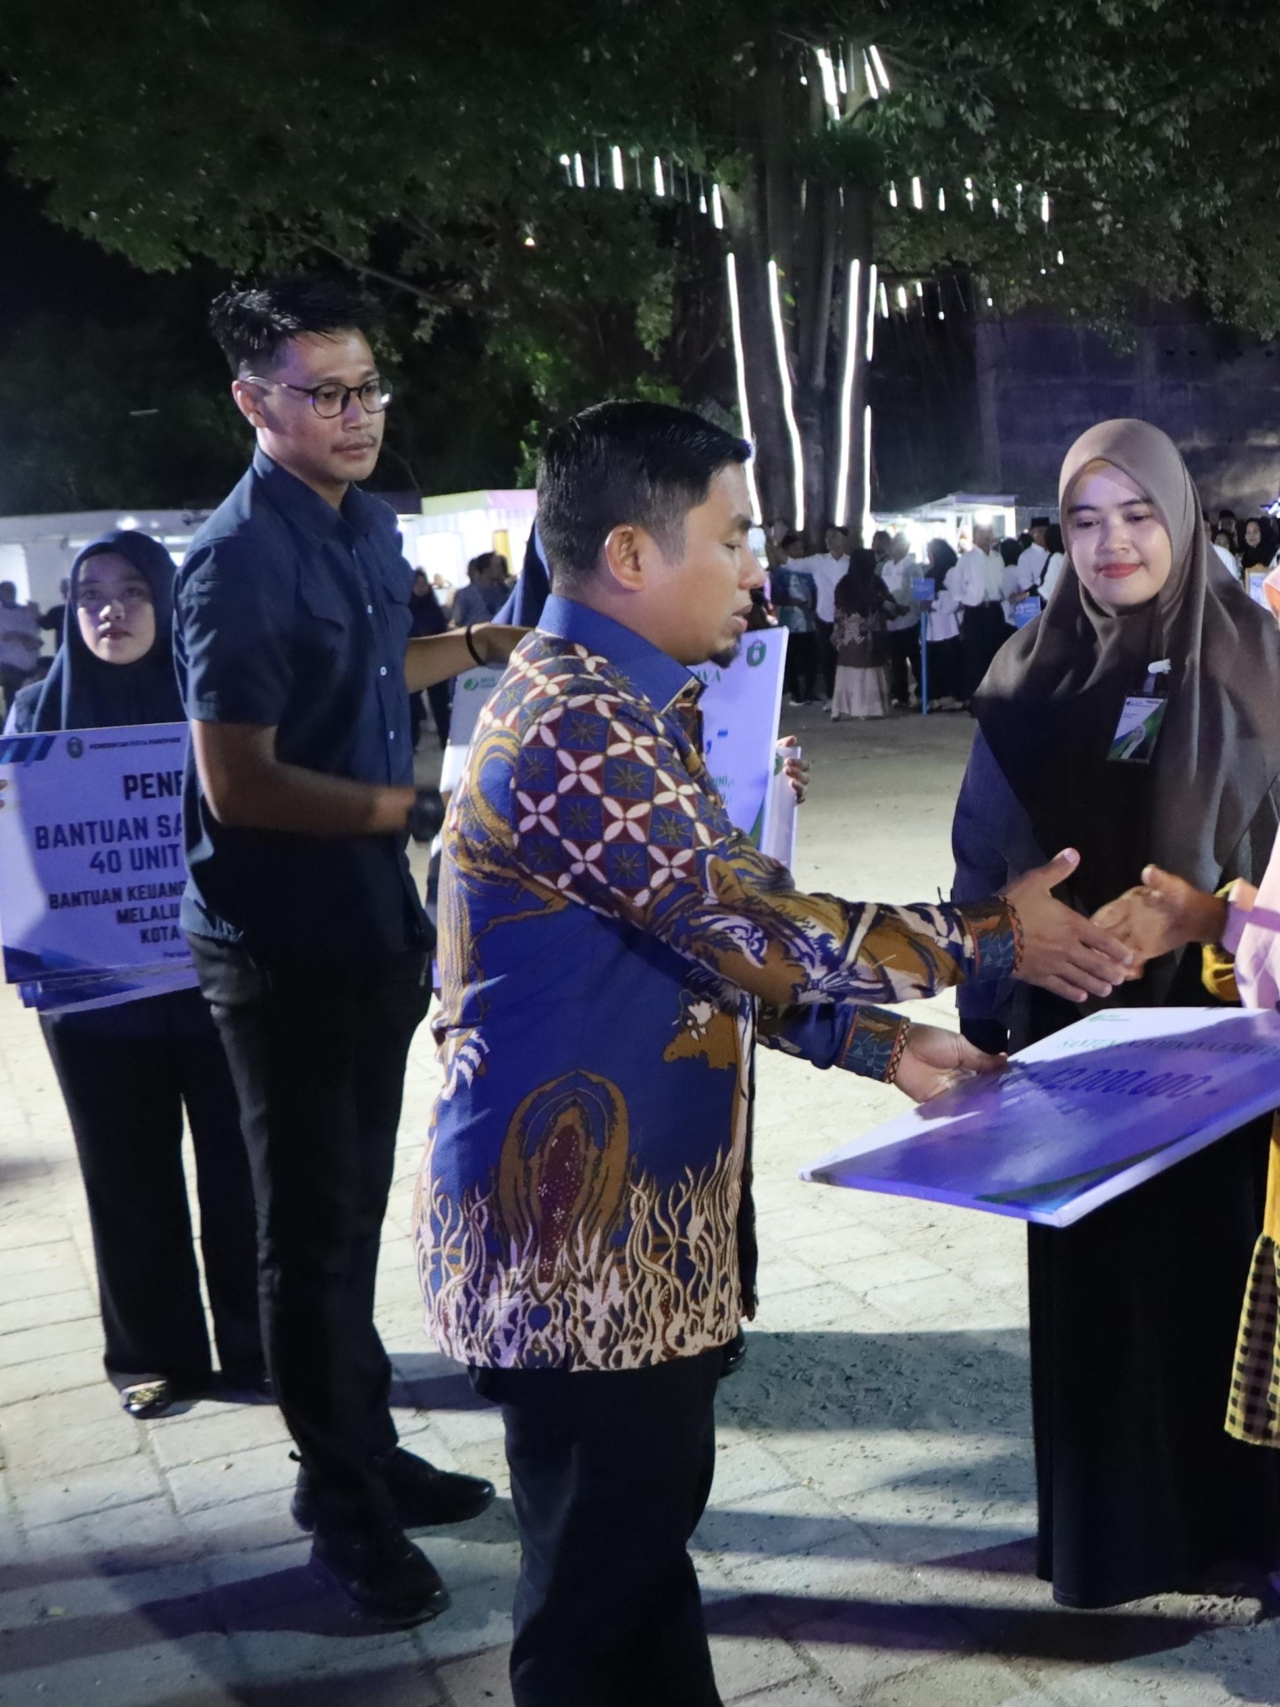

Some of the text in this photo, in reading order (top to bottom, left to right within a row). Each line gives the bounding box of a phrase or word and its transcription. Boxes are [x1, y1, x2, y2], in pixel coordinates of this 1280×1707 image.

[35, 816, 149, 850] BANTUAN
[89, 843, 180, 874] 40 UNIT
[50, 887, 123, 910] BANTUAN
[141, 925, 181, 944] KOTA
